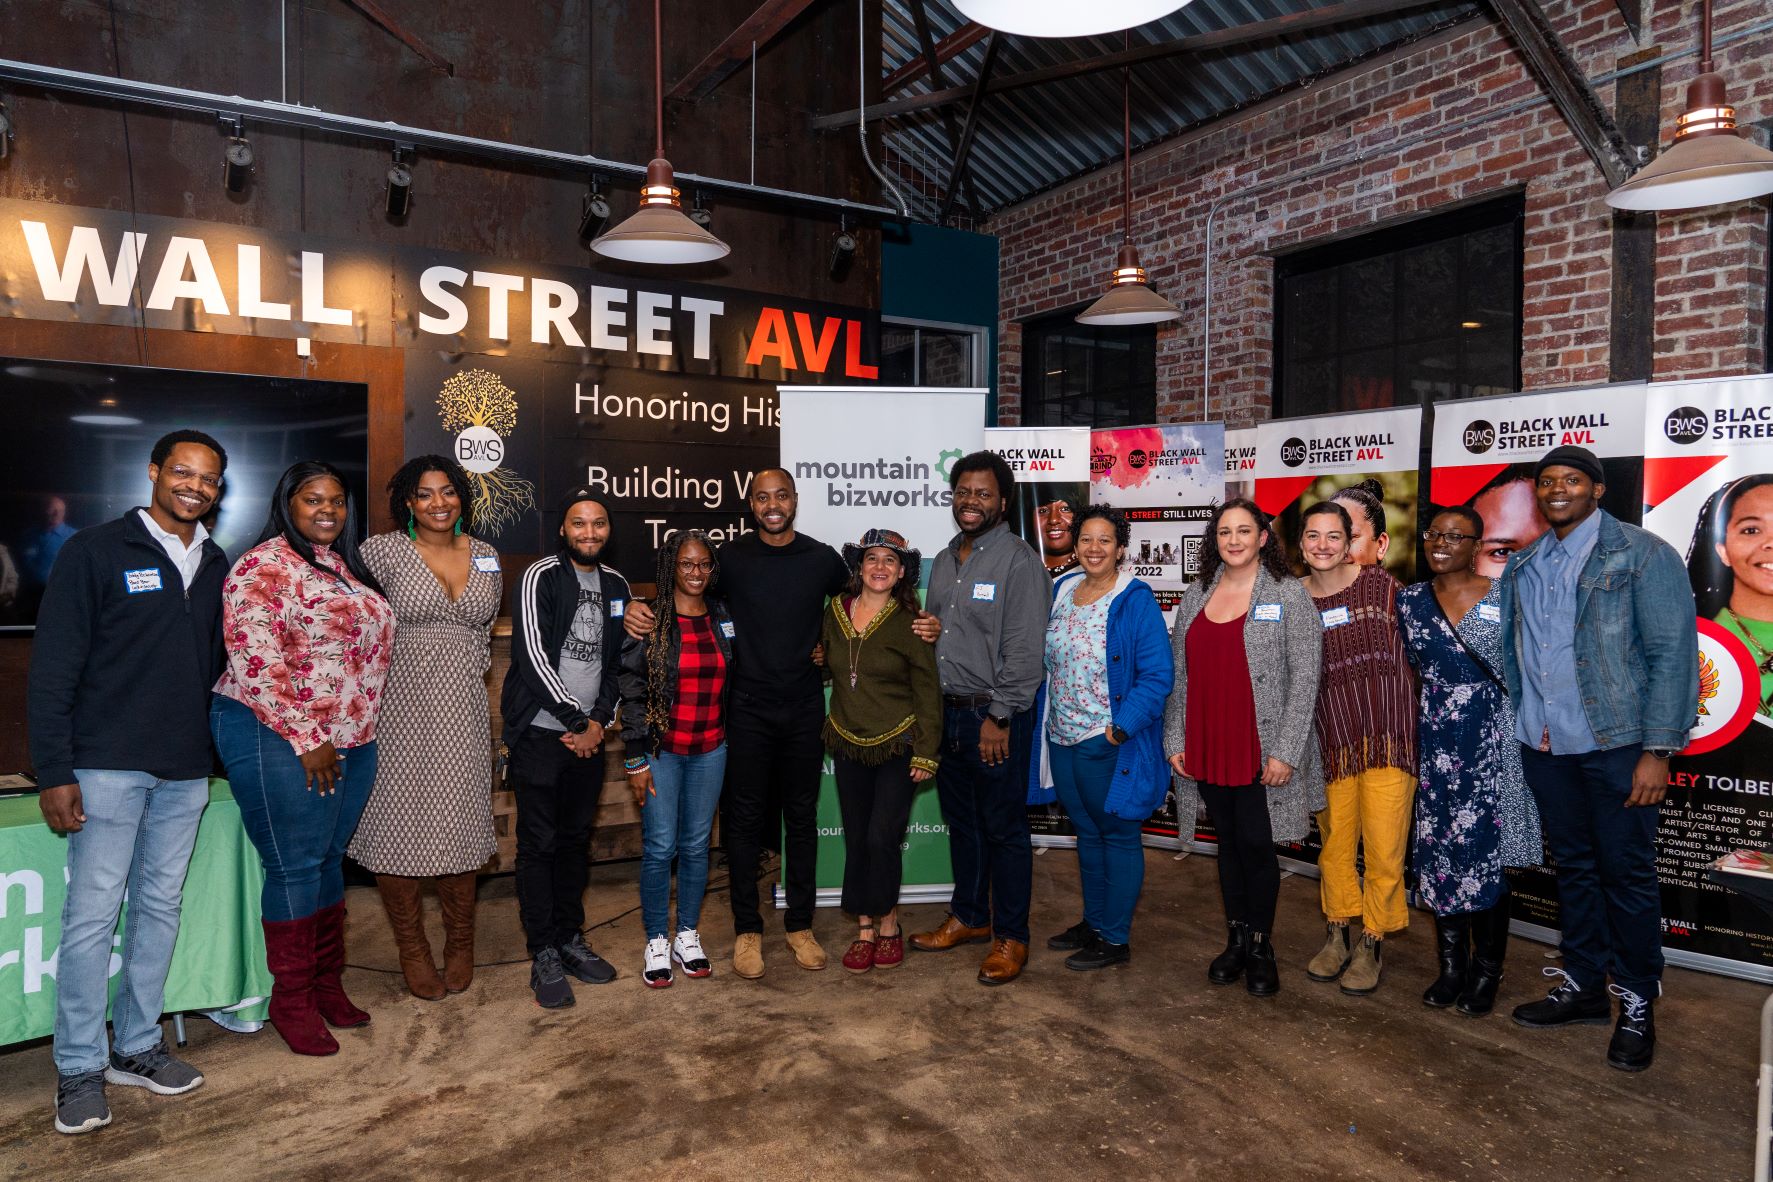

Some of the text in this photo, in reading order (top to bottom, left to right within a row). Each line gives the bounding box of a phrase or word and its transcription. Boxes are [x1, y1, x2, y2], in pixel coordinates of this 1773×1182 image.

[20, 220, 879, 380] WALL STREET AVL
[575, 383, 730, 433] Honoring
[1499, 413, 1609, 434] BLACK WALL
[1667, 416, 1706, 436] BWS
[1309, 433, 1394, 450] BLACK WALL
[1465, 429, 1494, 447] BWS
[1497, 430, 1595, 449] STREET AVL
[460, 438, 501, 461] BWS
[1027, 449, 1065, 459] WALL
[1149, 448, 1207, 458] BLACK WALL
[1282, 445, 1306, 461] BWS
[1308, 447, 1384, 464] STREET AVL
[795, 456, 930, 479] mountain
[1029, 461, 1056, 471] AVL
[1148, 457, 1200, 467] STREET AVL
[588, 465, 722, 509] Building
[827, 483, 953, 507] bizworks
[1131, 511, 1161, 519] STREET
[1163, 510, 1186, 518] STILL
[1187, 509, 1213, 518] LIVES
[1134, 566, 1163, 577] 2022
[1705, 775, 1773, 796] TOLBE
[1703, 803, 1746, 815] LICENSED
[1687, 810, 1717, 823] (LCAS)
[1720, 816, 1741, 824] AND
[1745, 818, 1767, 828] ONE
[1664, 818, 1762, 837] ARTIST/CREATOR OF
[1686, 831, 1708, 840] ARTS
[1663, 848, 1711, 860] PROMOTES
[1704, 844, 1732, 854] SMALL
[1681, 870, 1698, 879] ART
[1700, 882, 1723, 893] TWIN
[1669, 918, 1698, 931] WALL
[1670, 927, 1691, 936] AVL
[1704, 925, 1744, 937] HONORING
